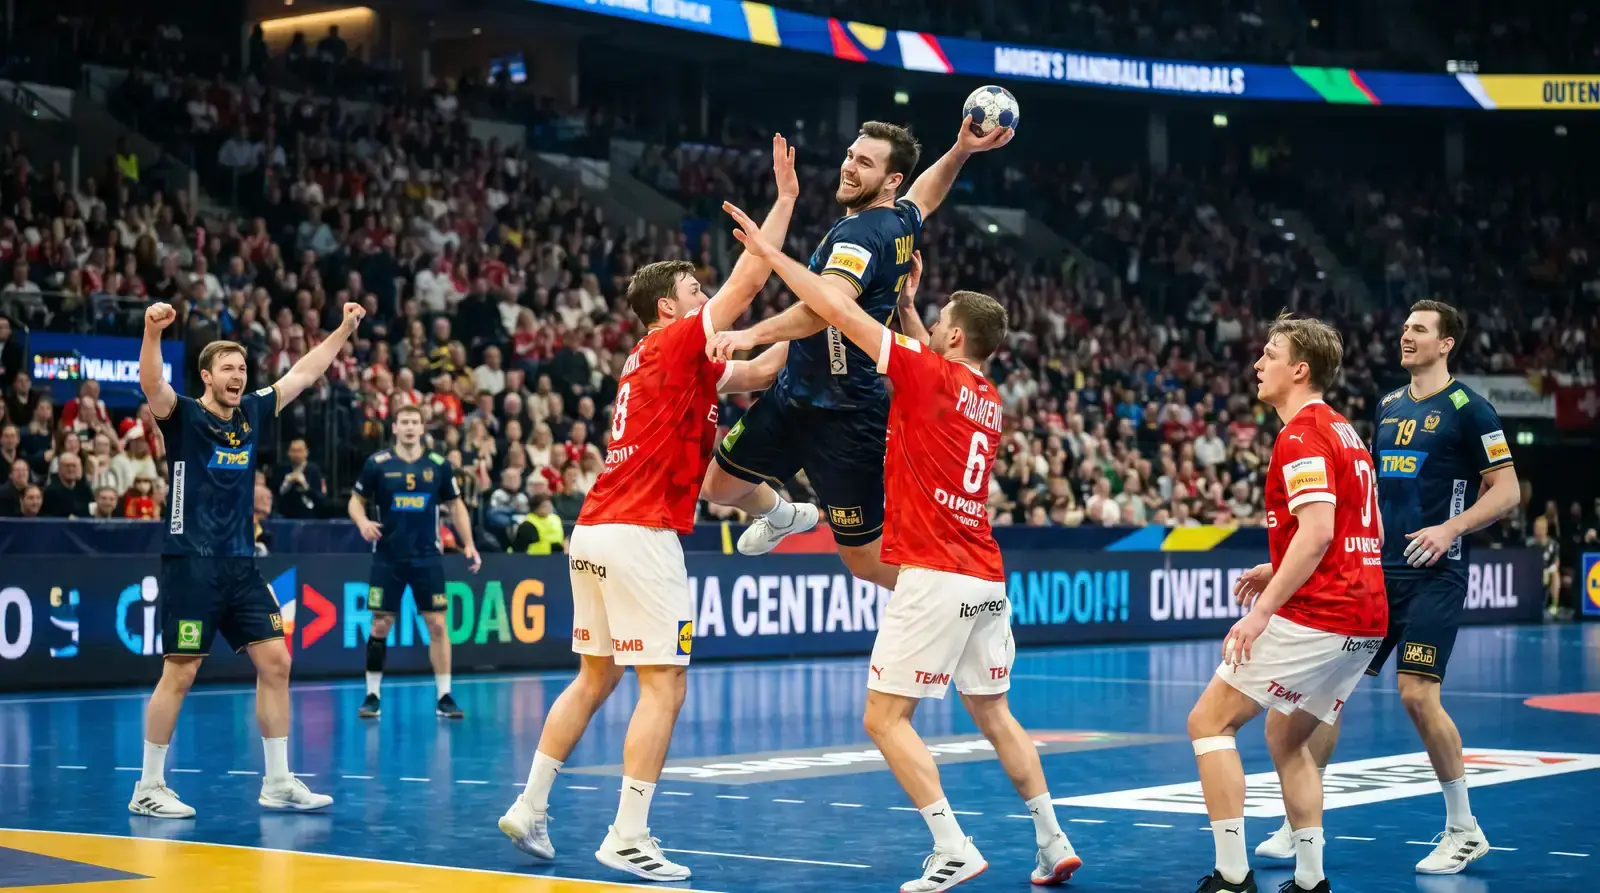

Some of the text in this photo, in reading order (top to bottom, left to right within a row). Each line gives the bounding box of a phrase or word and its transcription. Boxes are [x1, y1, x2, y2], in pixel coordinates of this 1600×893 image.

[1395, 419, 1416, 446] 19
[962, 431, 989, 493] 6
[405, 473, 416, 491] 5
